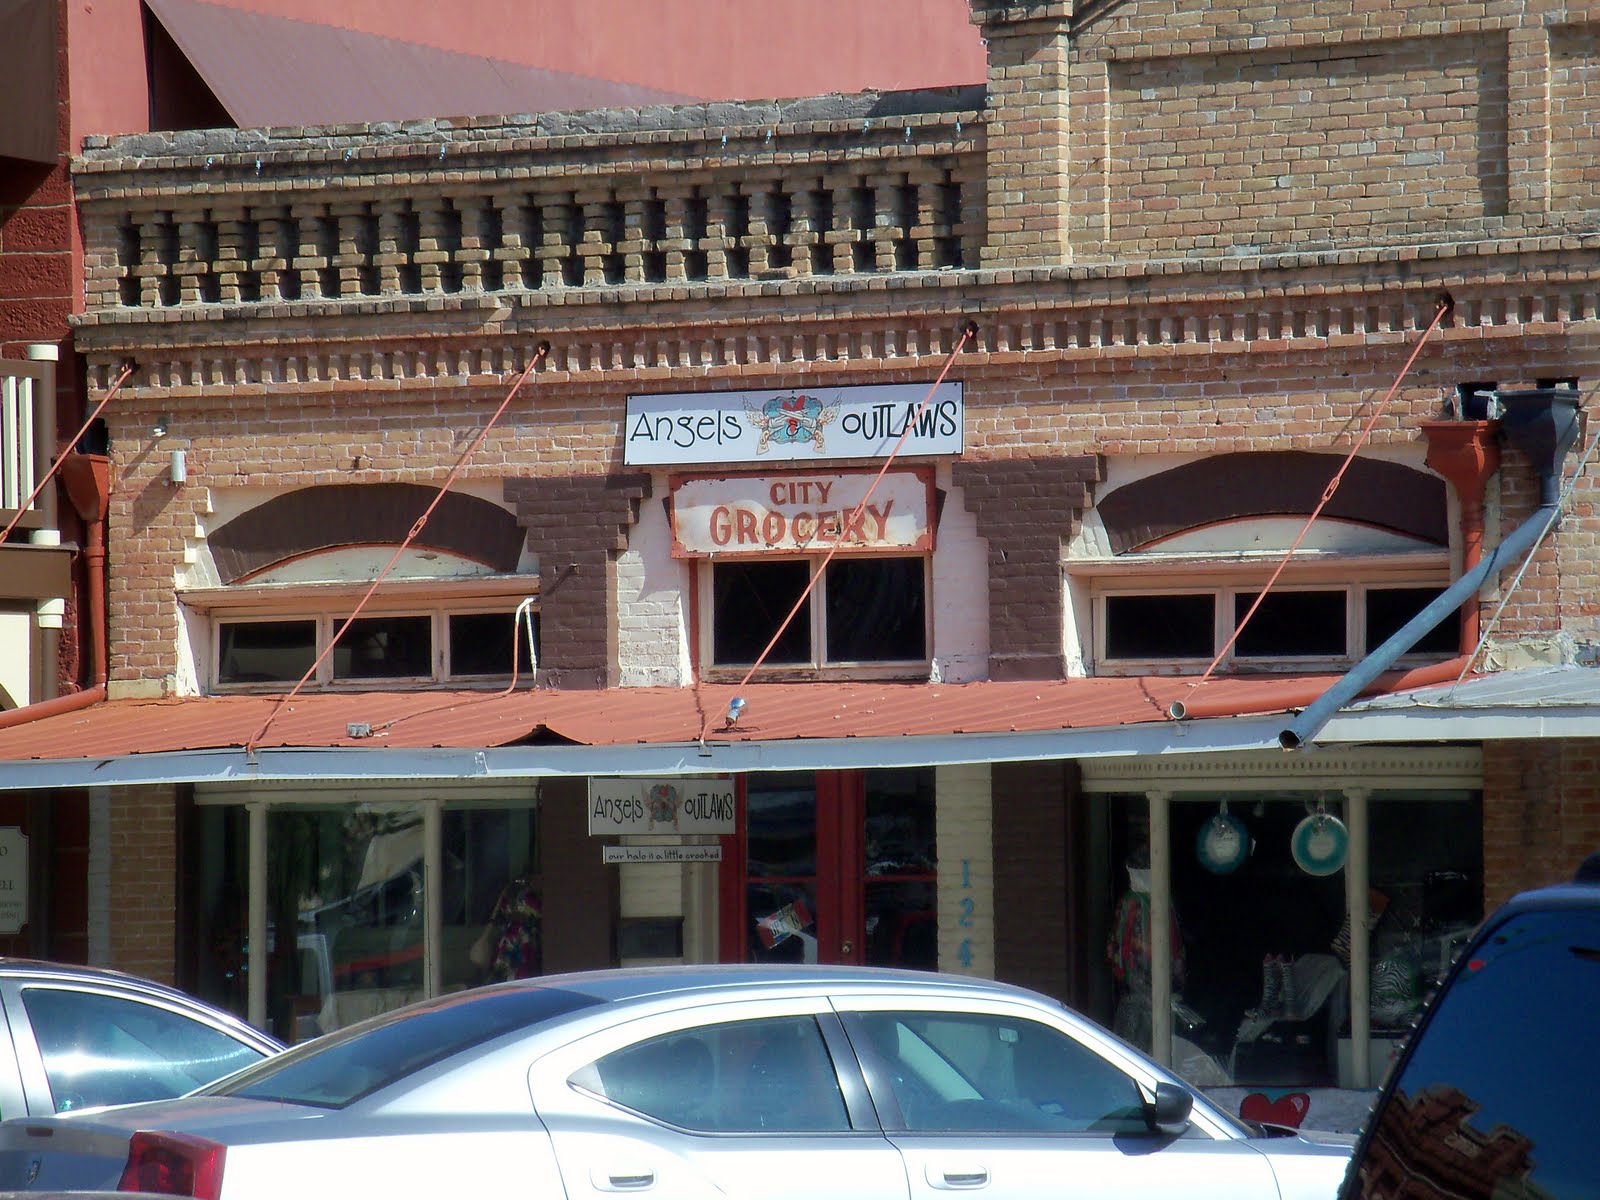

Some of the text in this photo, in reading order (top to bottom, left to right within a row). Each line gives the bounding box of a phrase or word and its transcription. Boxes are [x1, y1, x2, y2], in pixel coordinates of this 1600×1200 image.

[630, 409, 743, 448] Angels
[841, 399, 958, 441] OUTLAWS
[769, 480, 834, 506] CITY
[709, 499, 894, 547] GROCERY
[593, 792, 734, 824] Angels OUTLAWS
[608, 853, 625, 861] our
[626, 849, 647, 860] halo
[648, 850, 654, 860] is
[664, 849, 683, 860] little
[685, 849, 720, 860] crooked
[957, 858, 975, 968] 124
